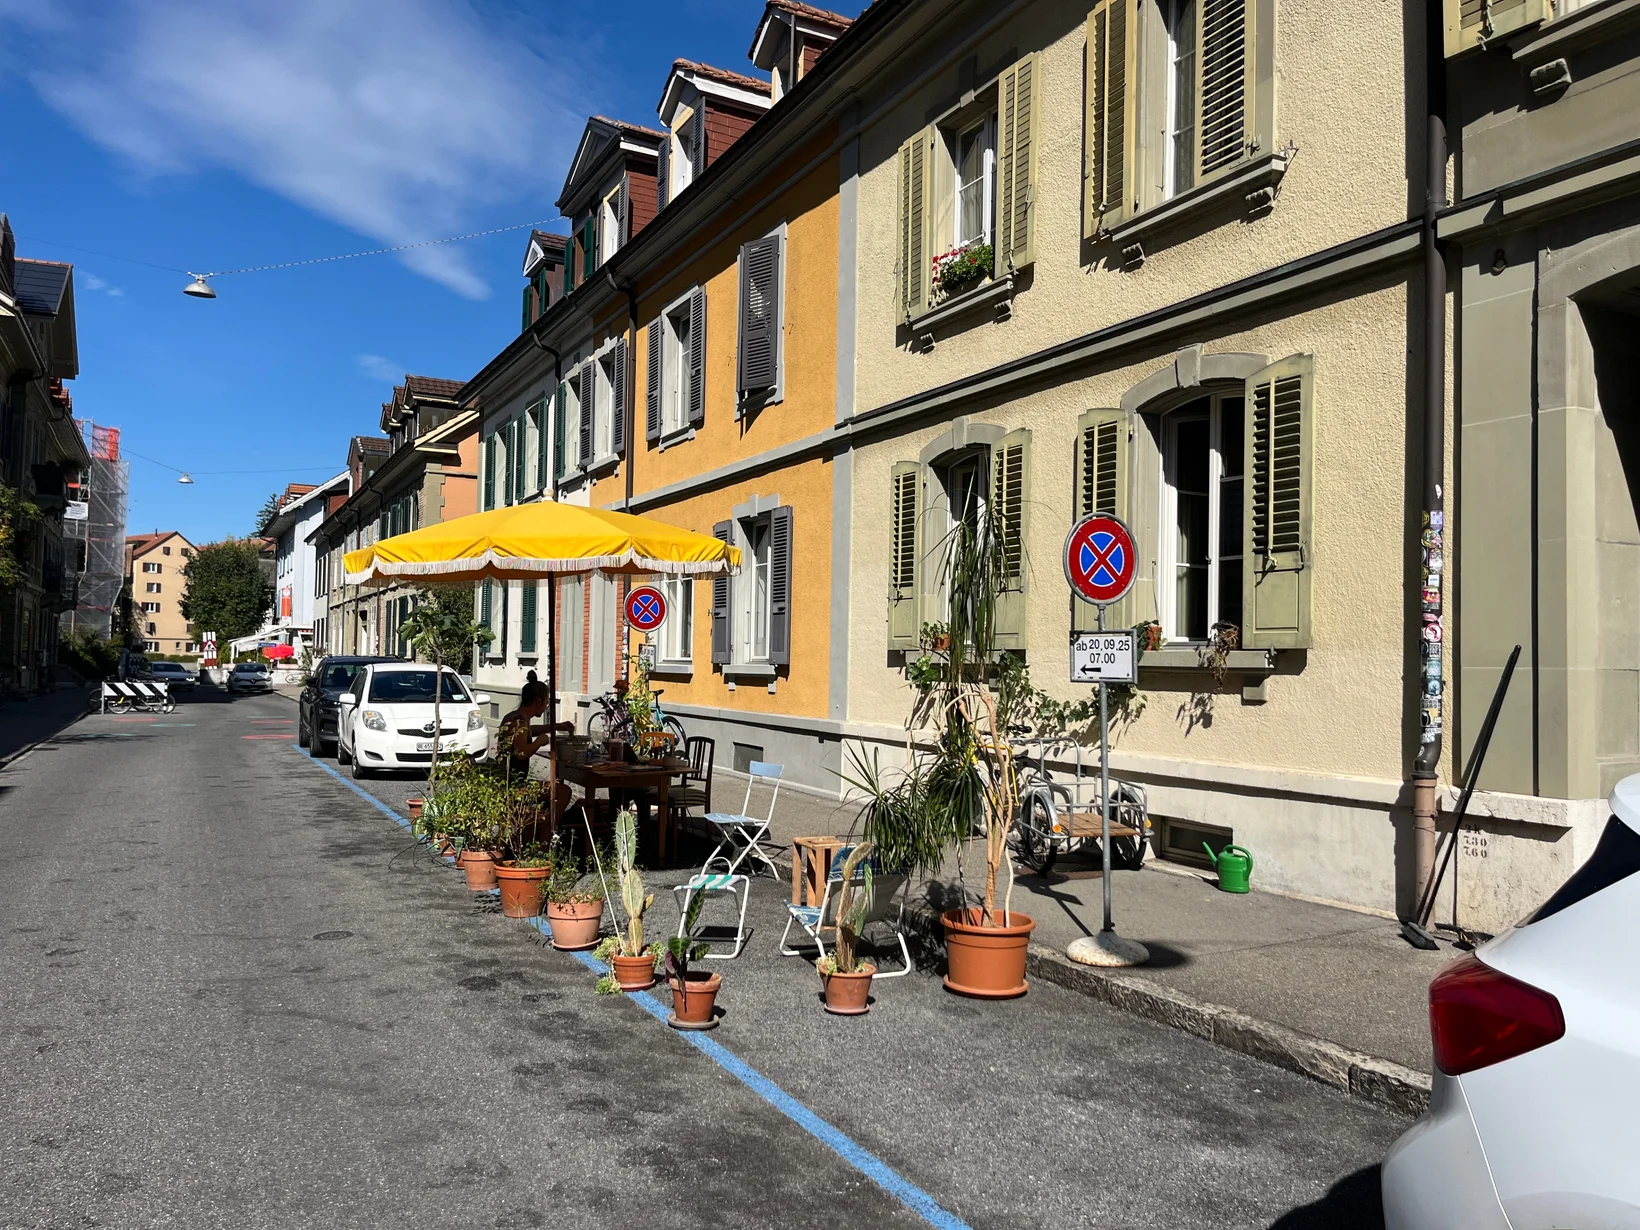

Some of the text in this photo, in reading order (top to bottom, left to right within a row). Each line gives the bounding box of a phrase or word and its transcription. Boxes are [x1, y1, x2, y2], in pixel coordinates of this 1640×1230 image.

[1076, 639, 1130, 651] ab 20.09.25
[1089, 653, 1115, 664] 07.00
